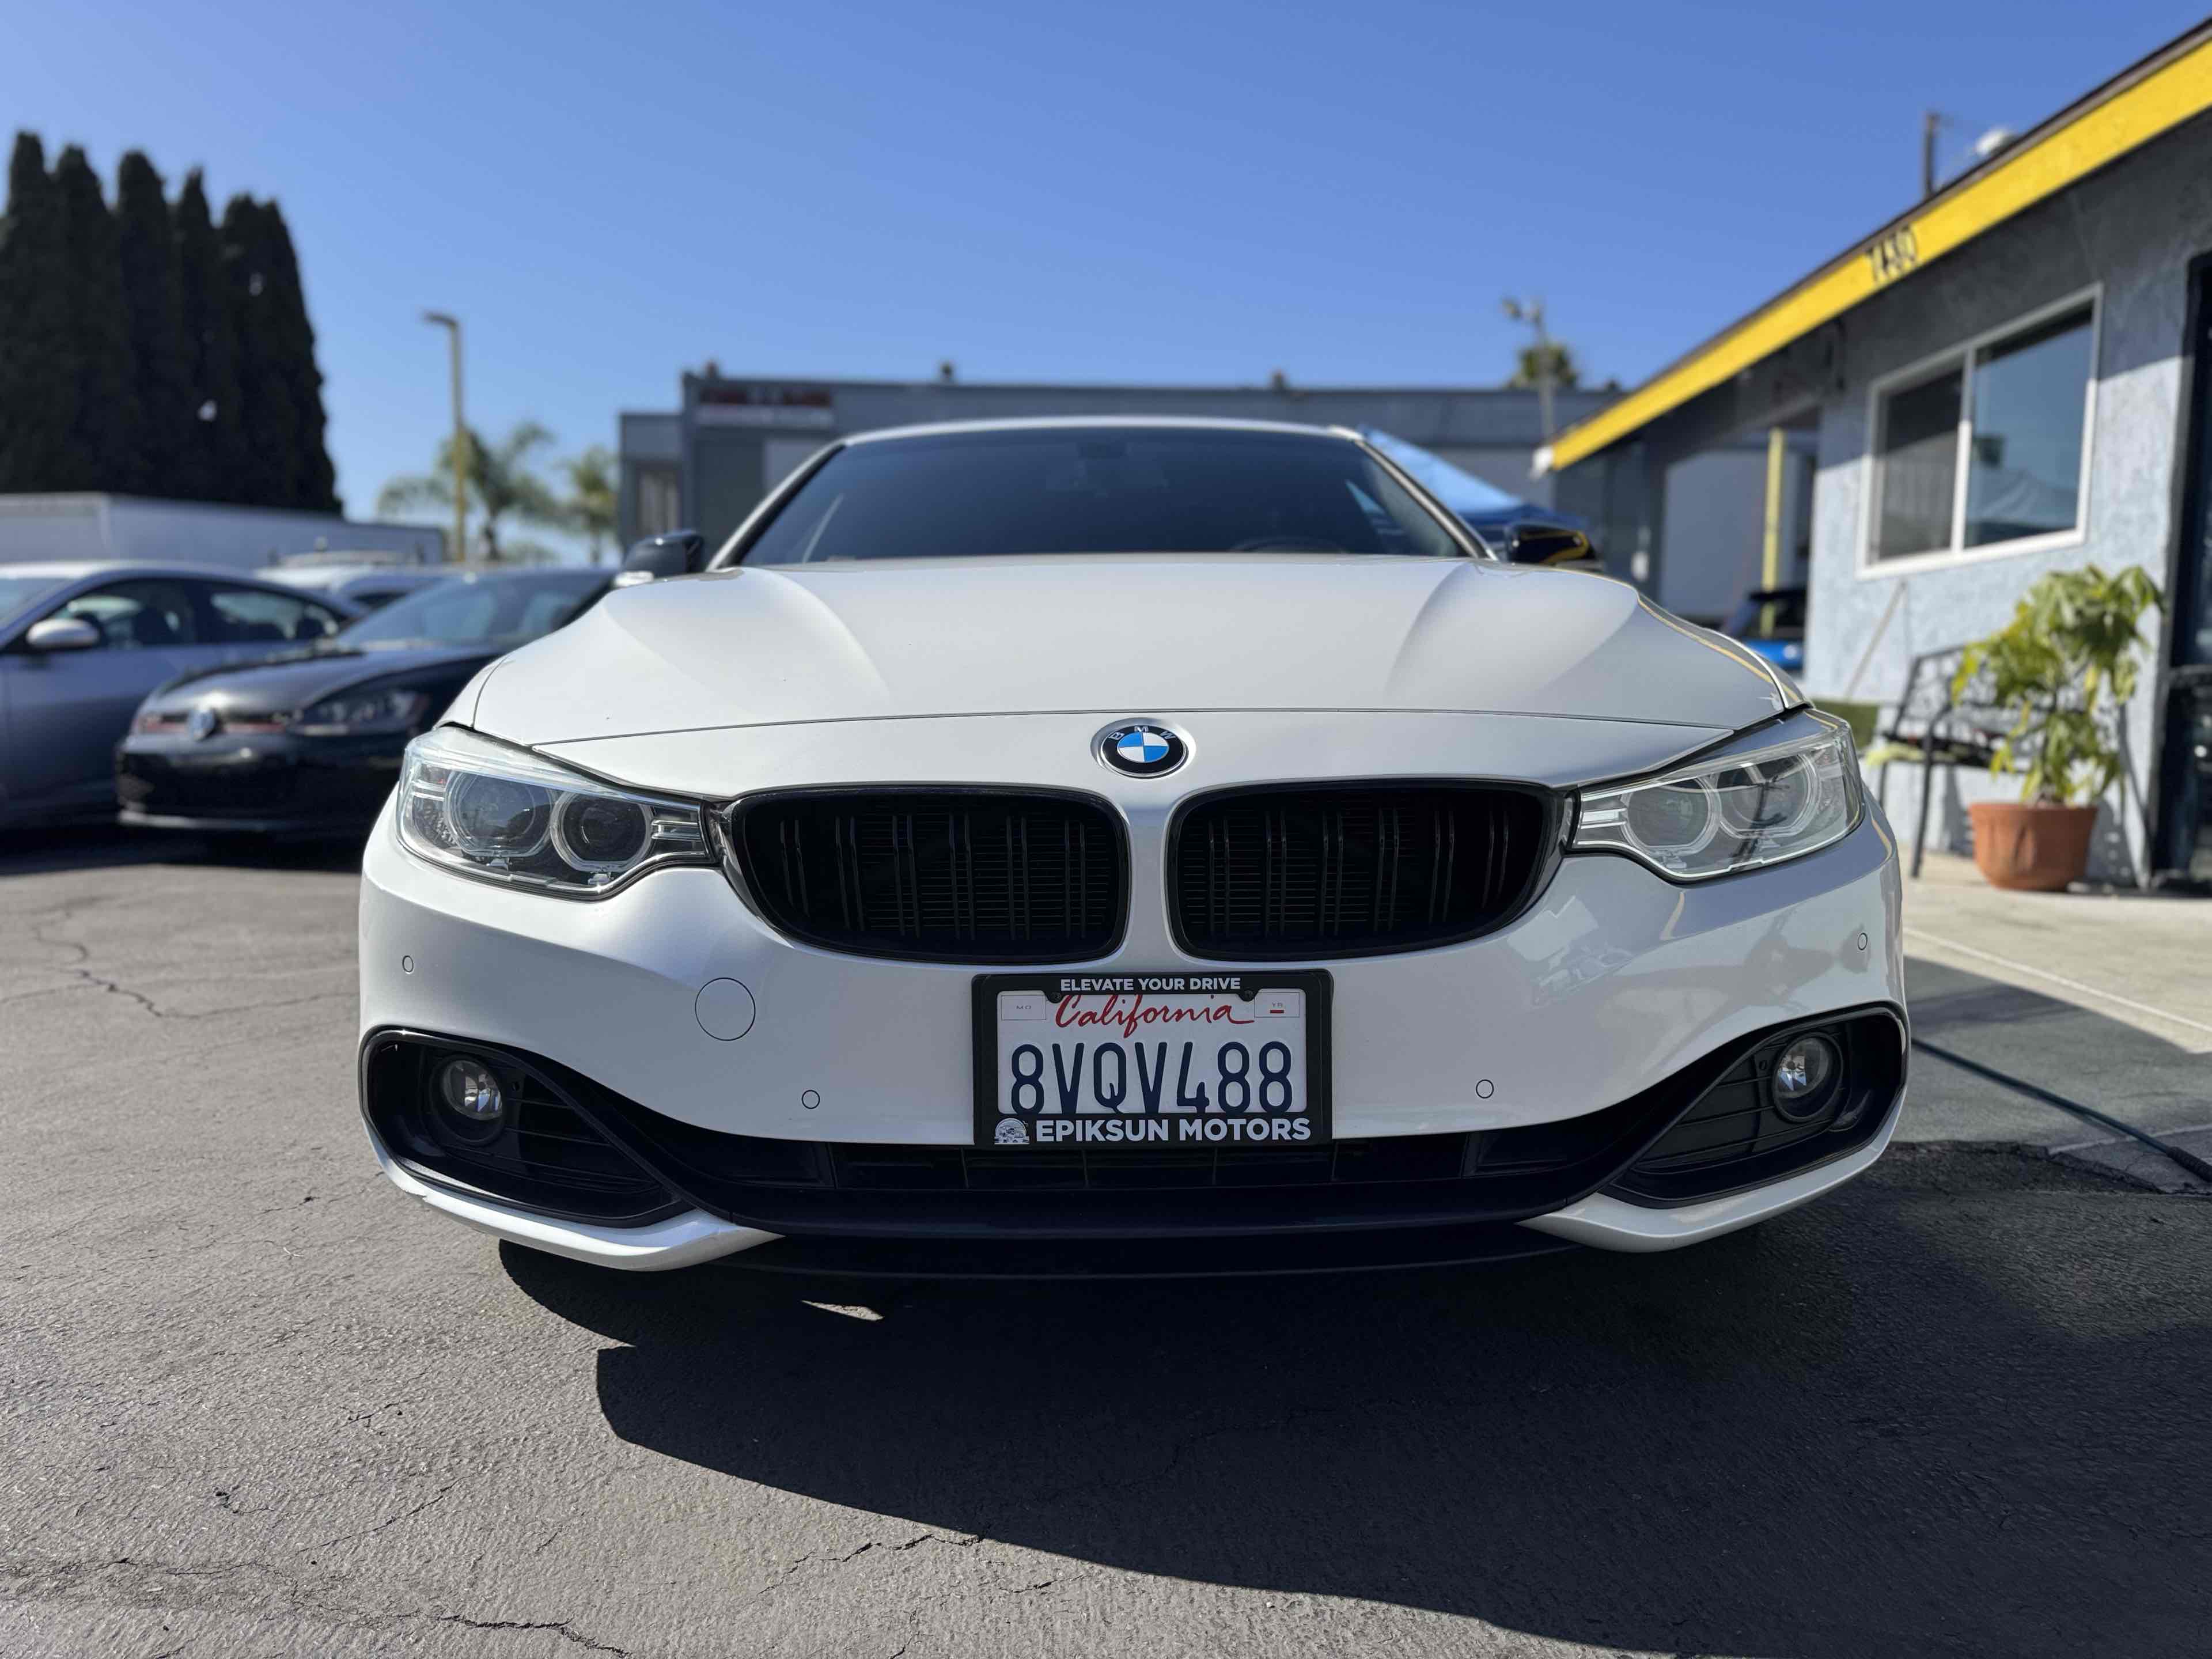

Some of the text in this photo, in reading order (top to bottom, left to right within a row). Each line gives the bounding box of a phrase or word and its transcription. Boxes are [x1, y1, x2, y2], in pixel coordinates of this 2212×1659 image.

[1108, 726, 1176, 740] BMW
[1060, 978, 1241, 991] ELEVATE YOUR DRIVE
[1055, 994, 1255, 1038] California
[1011, 1041, 1293, 1114] 8VQV488
[1036, 1118, 1312, 1142] EPIKSUN MOTORS
